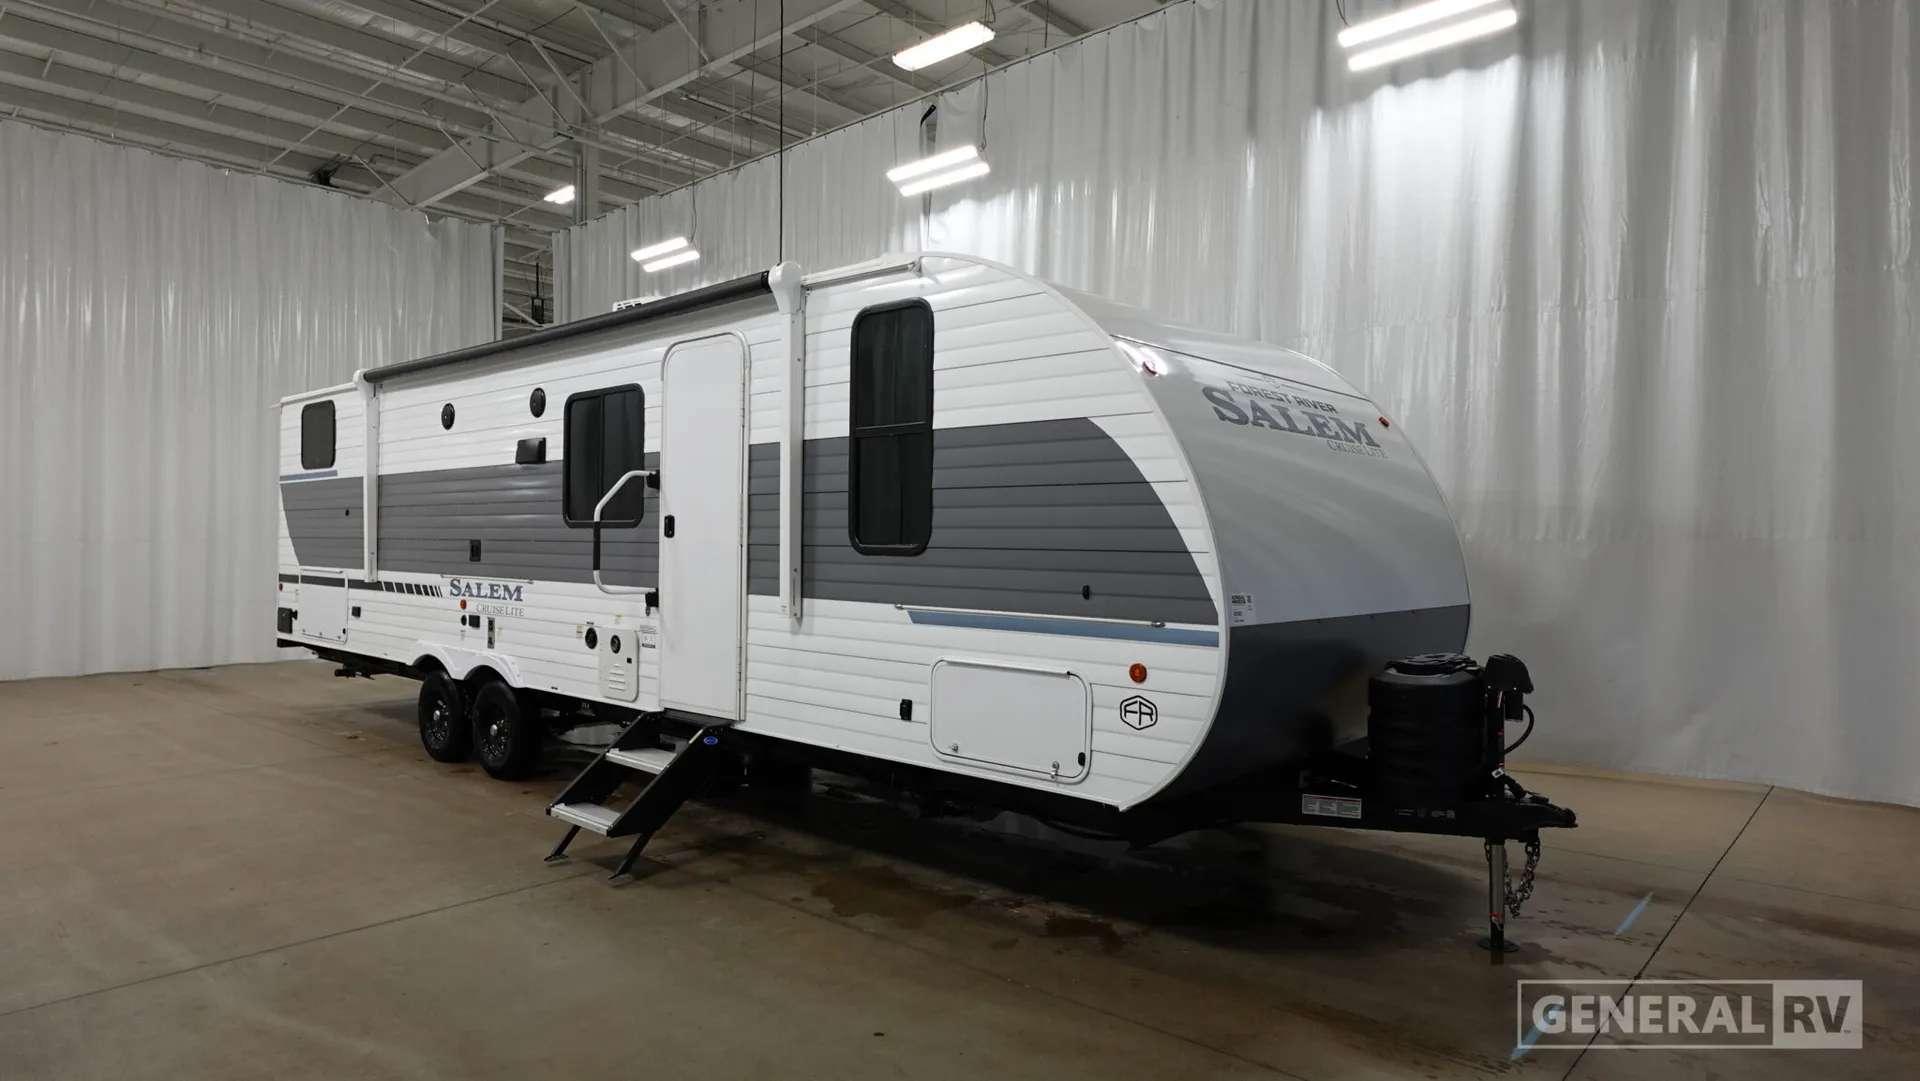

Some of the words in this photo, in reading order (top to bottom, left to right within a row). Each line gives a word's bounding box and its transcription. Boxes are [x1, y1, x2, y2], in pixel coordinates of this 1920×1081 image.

[1226, 381, 1292, 404] FOREST
[1292, 395, 1340, 415] RIVER
[1202, 385, 1381, 448] SALEM
[450, 577, 524, 602] SALEM
[1123, 700, 1154, 726] FR
